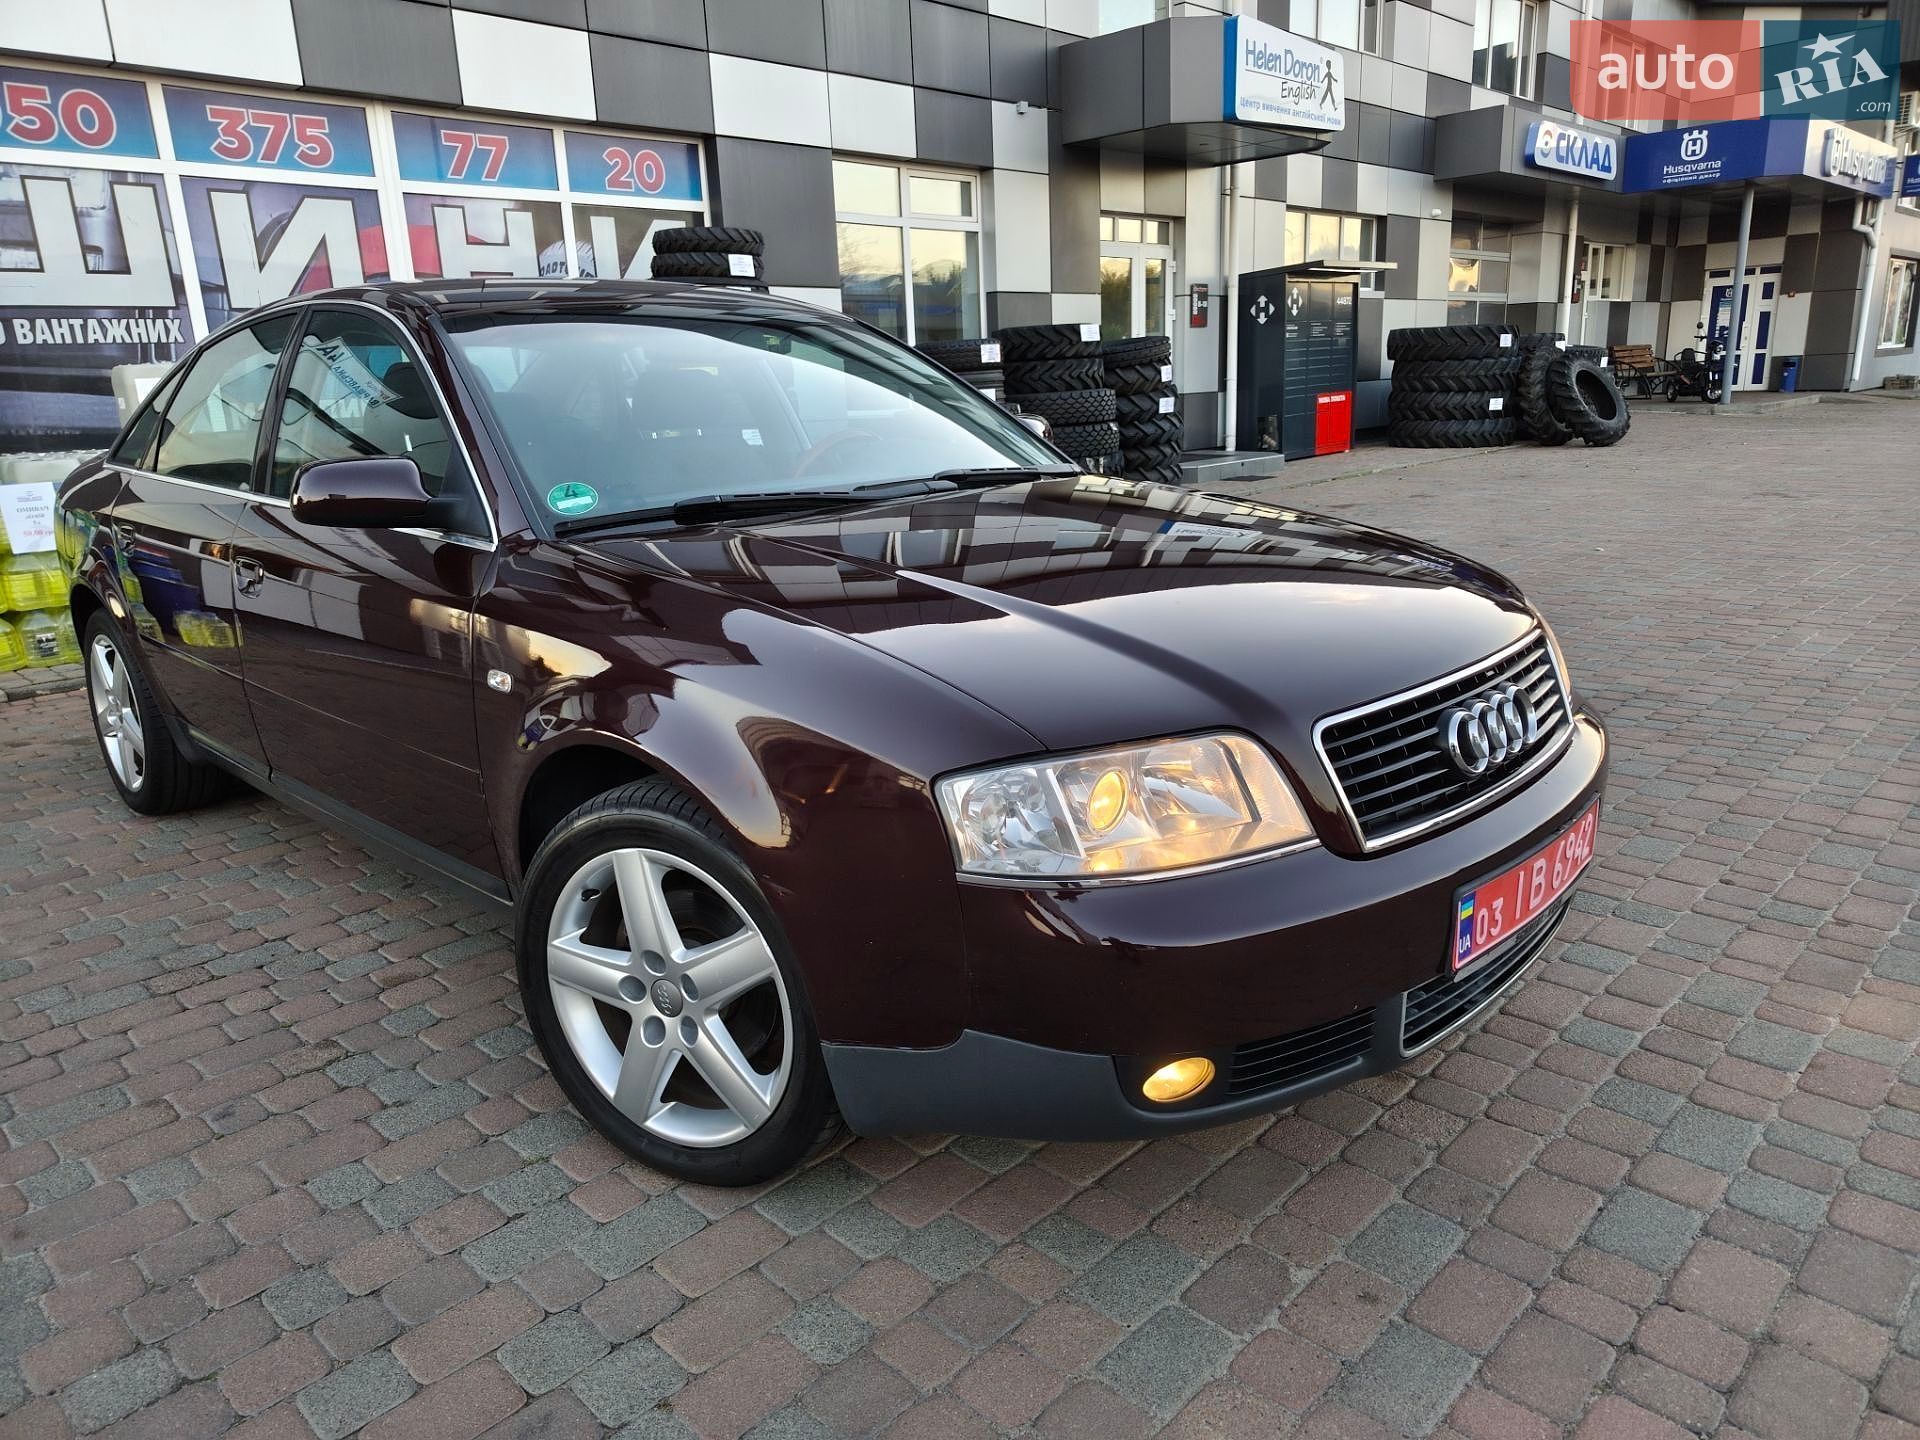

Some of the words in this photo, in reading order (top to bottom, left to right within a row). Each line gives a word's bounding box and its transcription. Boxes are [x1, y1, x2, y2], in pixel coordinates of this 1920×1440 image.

[1245, 38, 1282, 73] Helen
[1284, 48, 1320, 82] Doron
[1240, 96, 1261, 111] Центр
[1281, 80, 1317, 105] English
[0, 82, 117, 149] 50
[206, 104, 334, 168] 375
[440, 130, 509, 181] 77
[602, 146, 665, 194] 20
[1556, 132, 1612, 174] СКЛАД
[1663, 160, 1722, 175] Husqvarna
[12, 317, 185, 344] ВАНТАЖНИХ
[1475, 896, 1504, 945] 03
[1515, 857, 1547, 921] IB
[1459, 934, 1470, 953] UA
